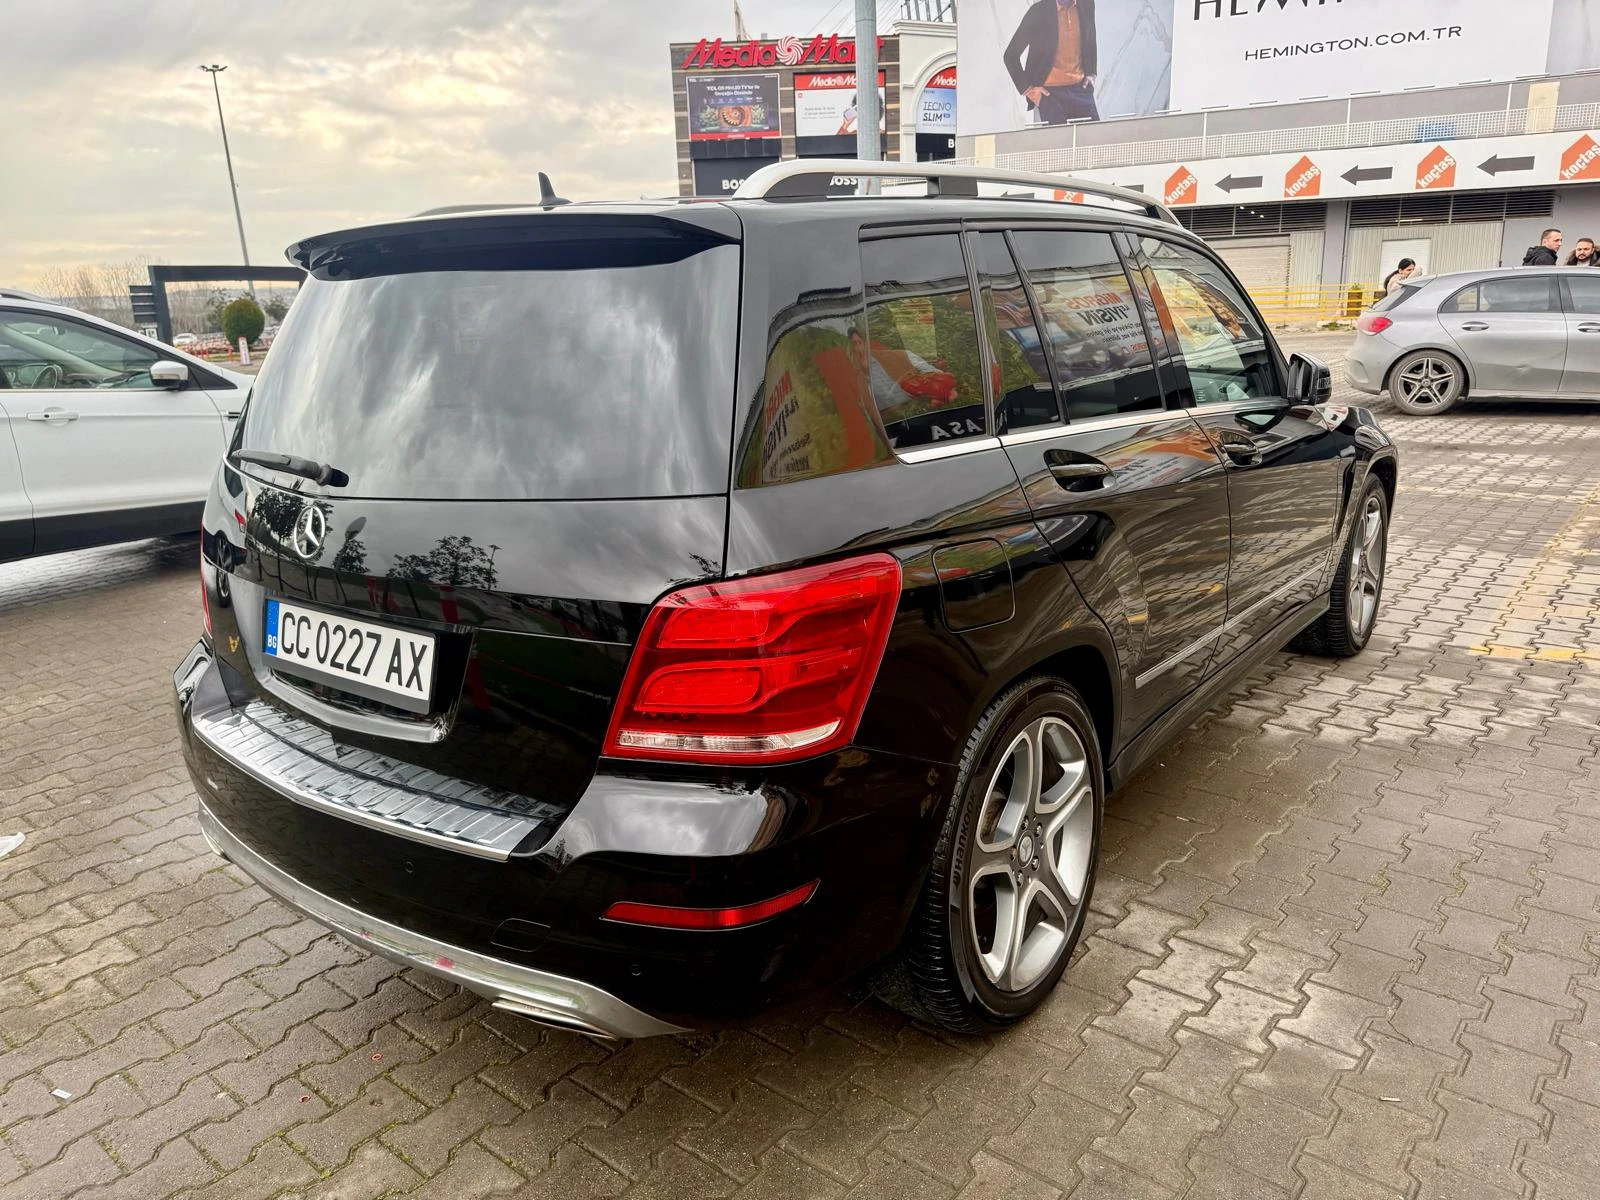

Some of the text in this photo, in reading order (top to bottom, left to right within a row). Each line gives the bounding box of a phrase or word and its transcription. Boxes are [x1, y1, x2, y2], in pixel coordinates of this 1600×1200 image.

[682, 38, 776, 69] Media
[1245, 26, 1462, 61] HEMINGTON.COM.TR
[922, 112, 943, 122] SLIM
[1285, 165, 1321, 197] koçtaş
[1416, 155, 1456, 189] koçtaş
[1165, 174, 1197, 204] koçtaş
[267, 634, 277, 649] BG
[281, 611, 428, 692] CC 0227 AX
